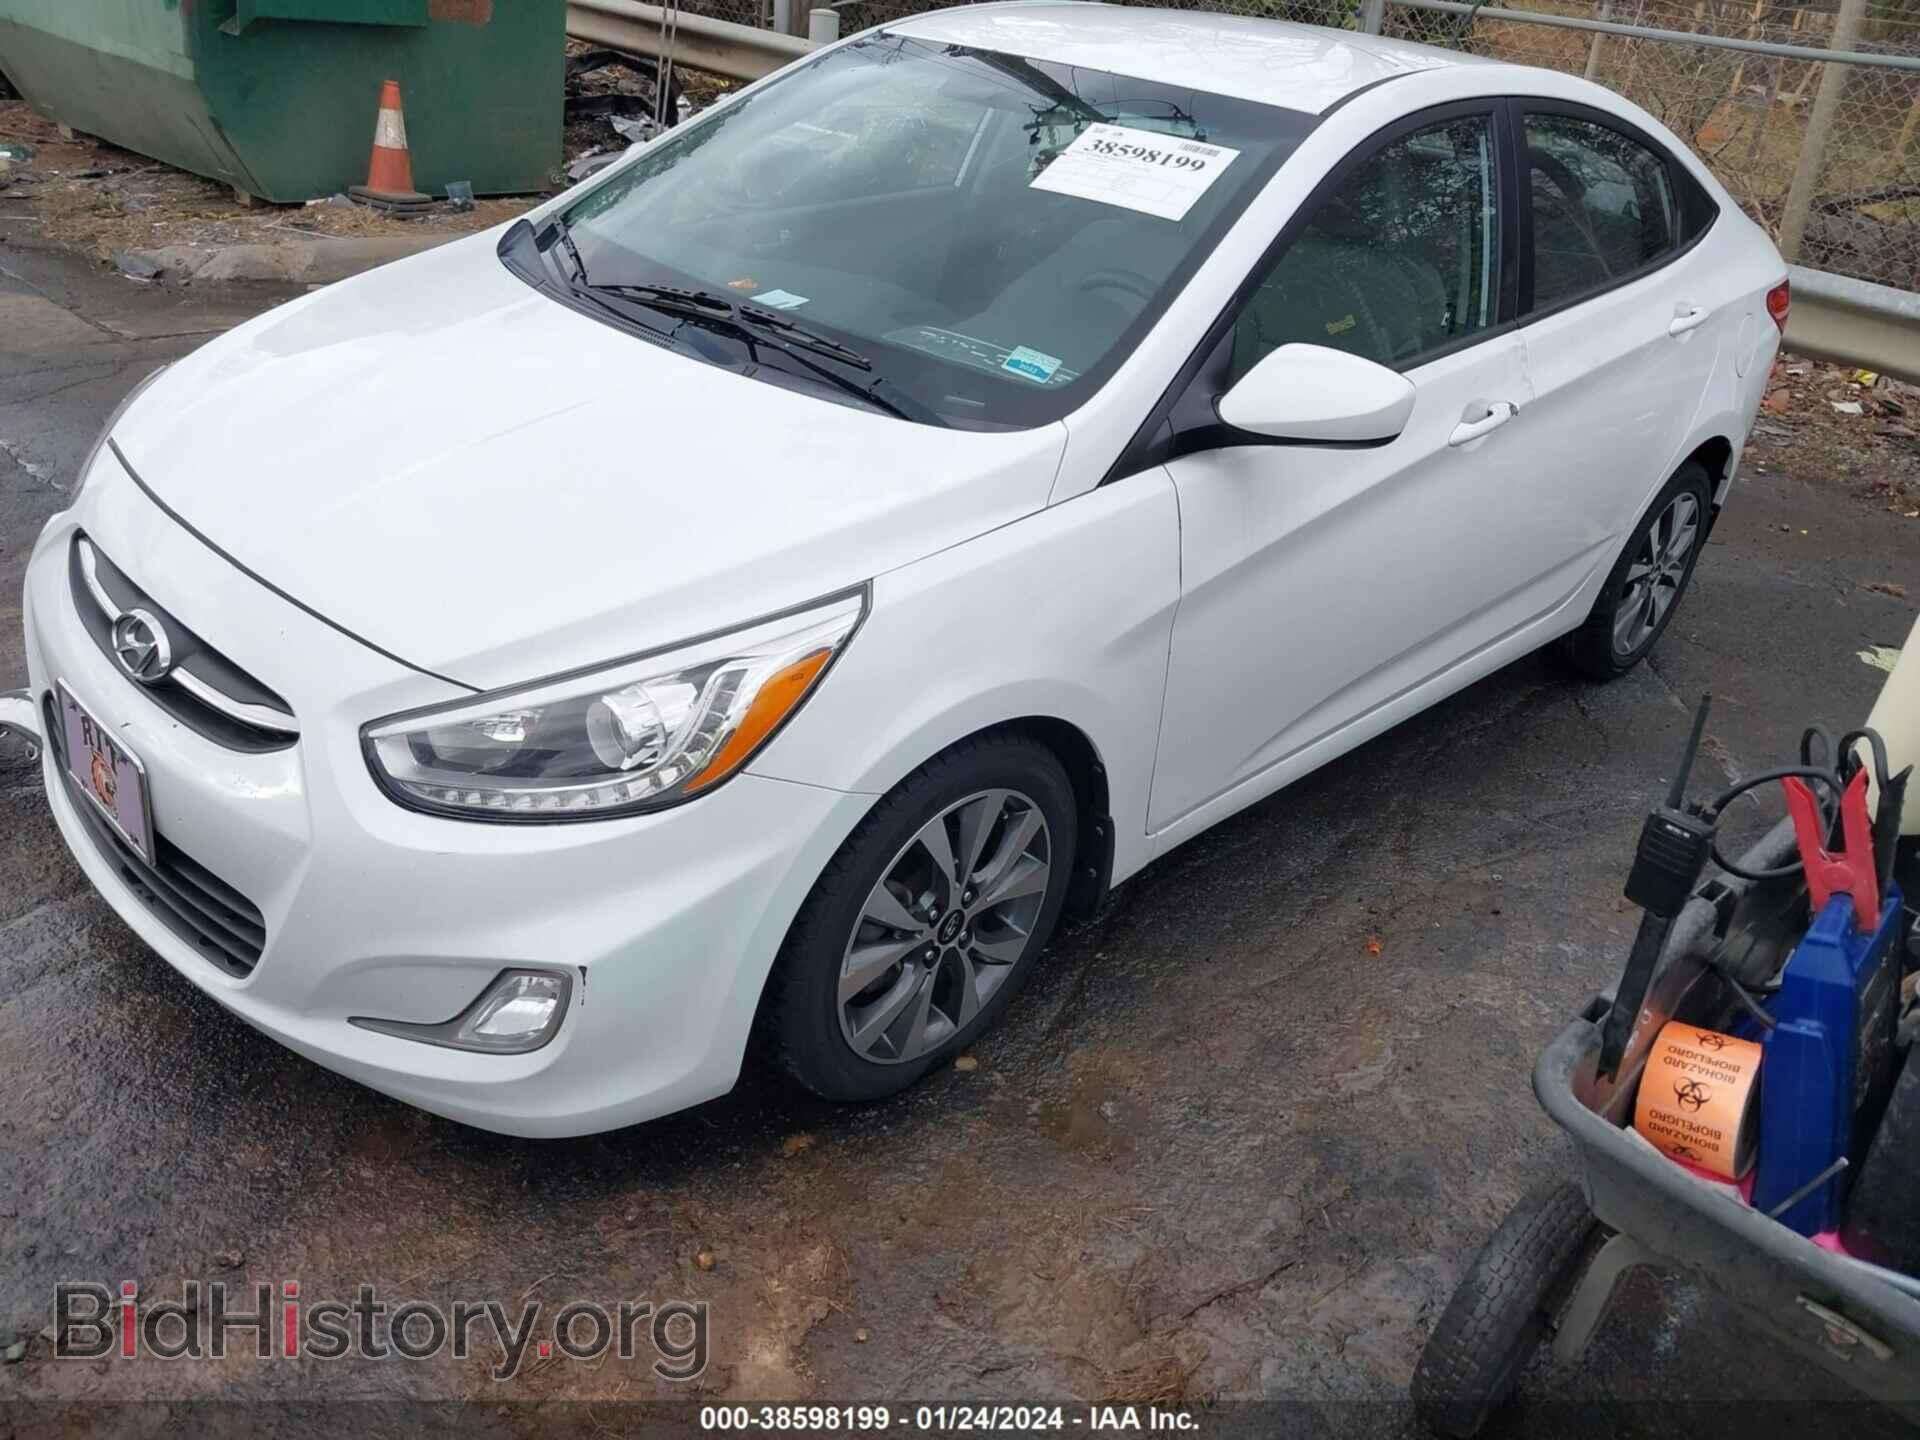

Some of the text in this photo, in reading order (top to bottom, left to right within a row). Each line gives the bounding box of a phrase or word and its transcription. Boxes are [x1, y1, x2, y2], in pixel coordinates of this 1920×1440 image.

[1083, 139, 1206, 172] 38598199
[1663, 1055, 1736, 1084] BIOHAZARD
[1667, 1045, 1741, 1073] BIOPELIGRO
[1648, 1121, 1719, 1152] BIOHAZARD
[1650, 1109, 1722, 1140] BIOPELIGRO
